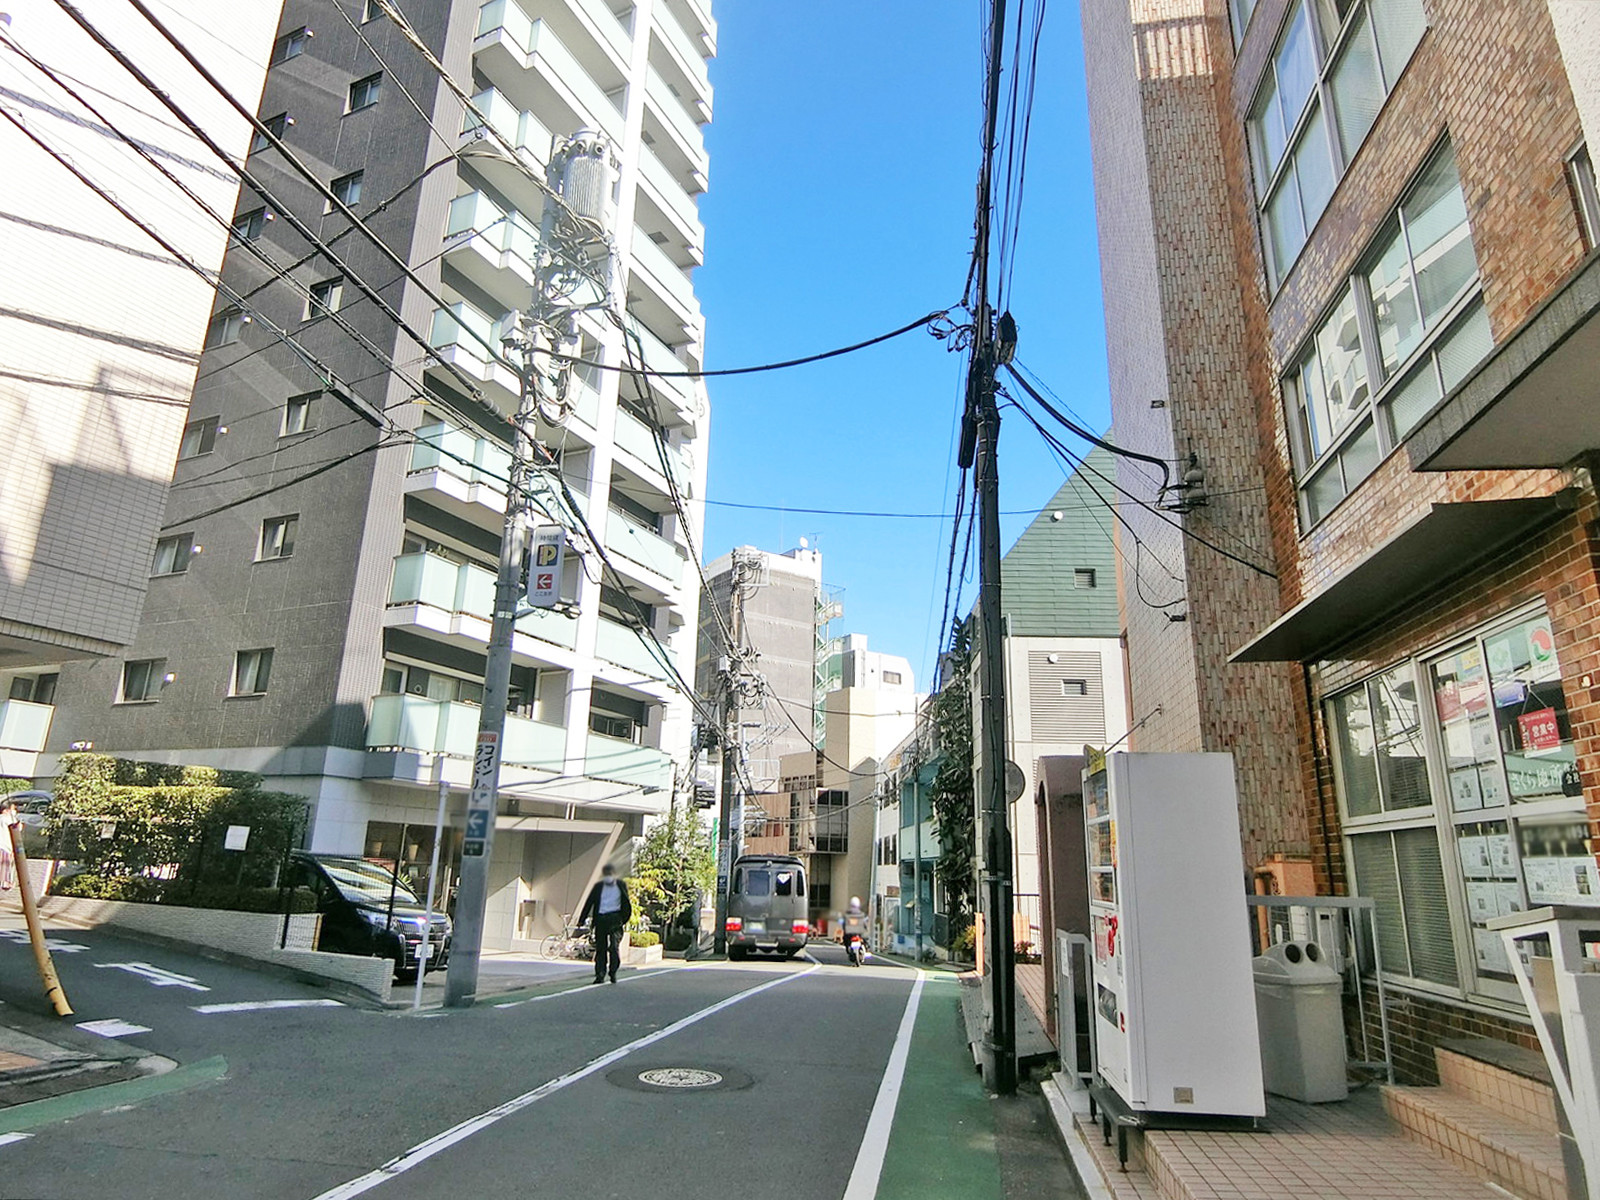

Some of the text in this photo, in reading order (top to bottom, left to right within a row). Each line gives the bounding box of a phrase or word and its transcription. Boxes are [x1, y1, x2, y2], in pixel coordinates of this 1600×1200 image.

[539, 545, 557, 566] P
[1531, 721, 1555, 738] 営業中
[482, 744, 495, 776] コイン
